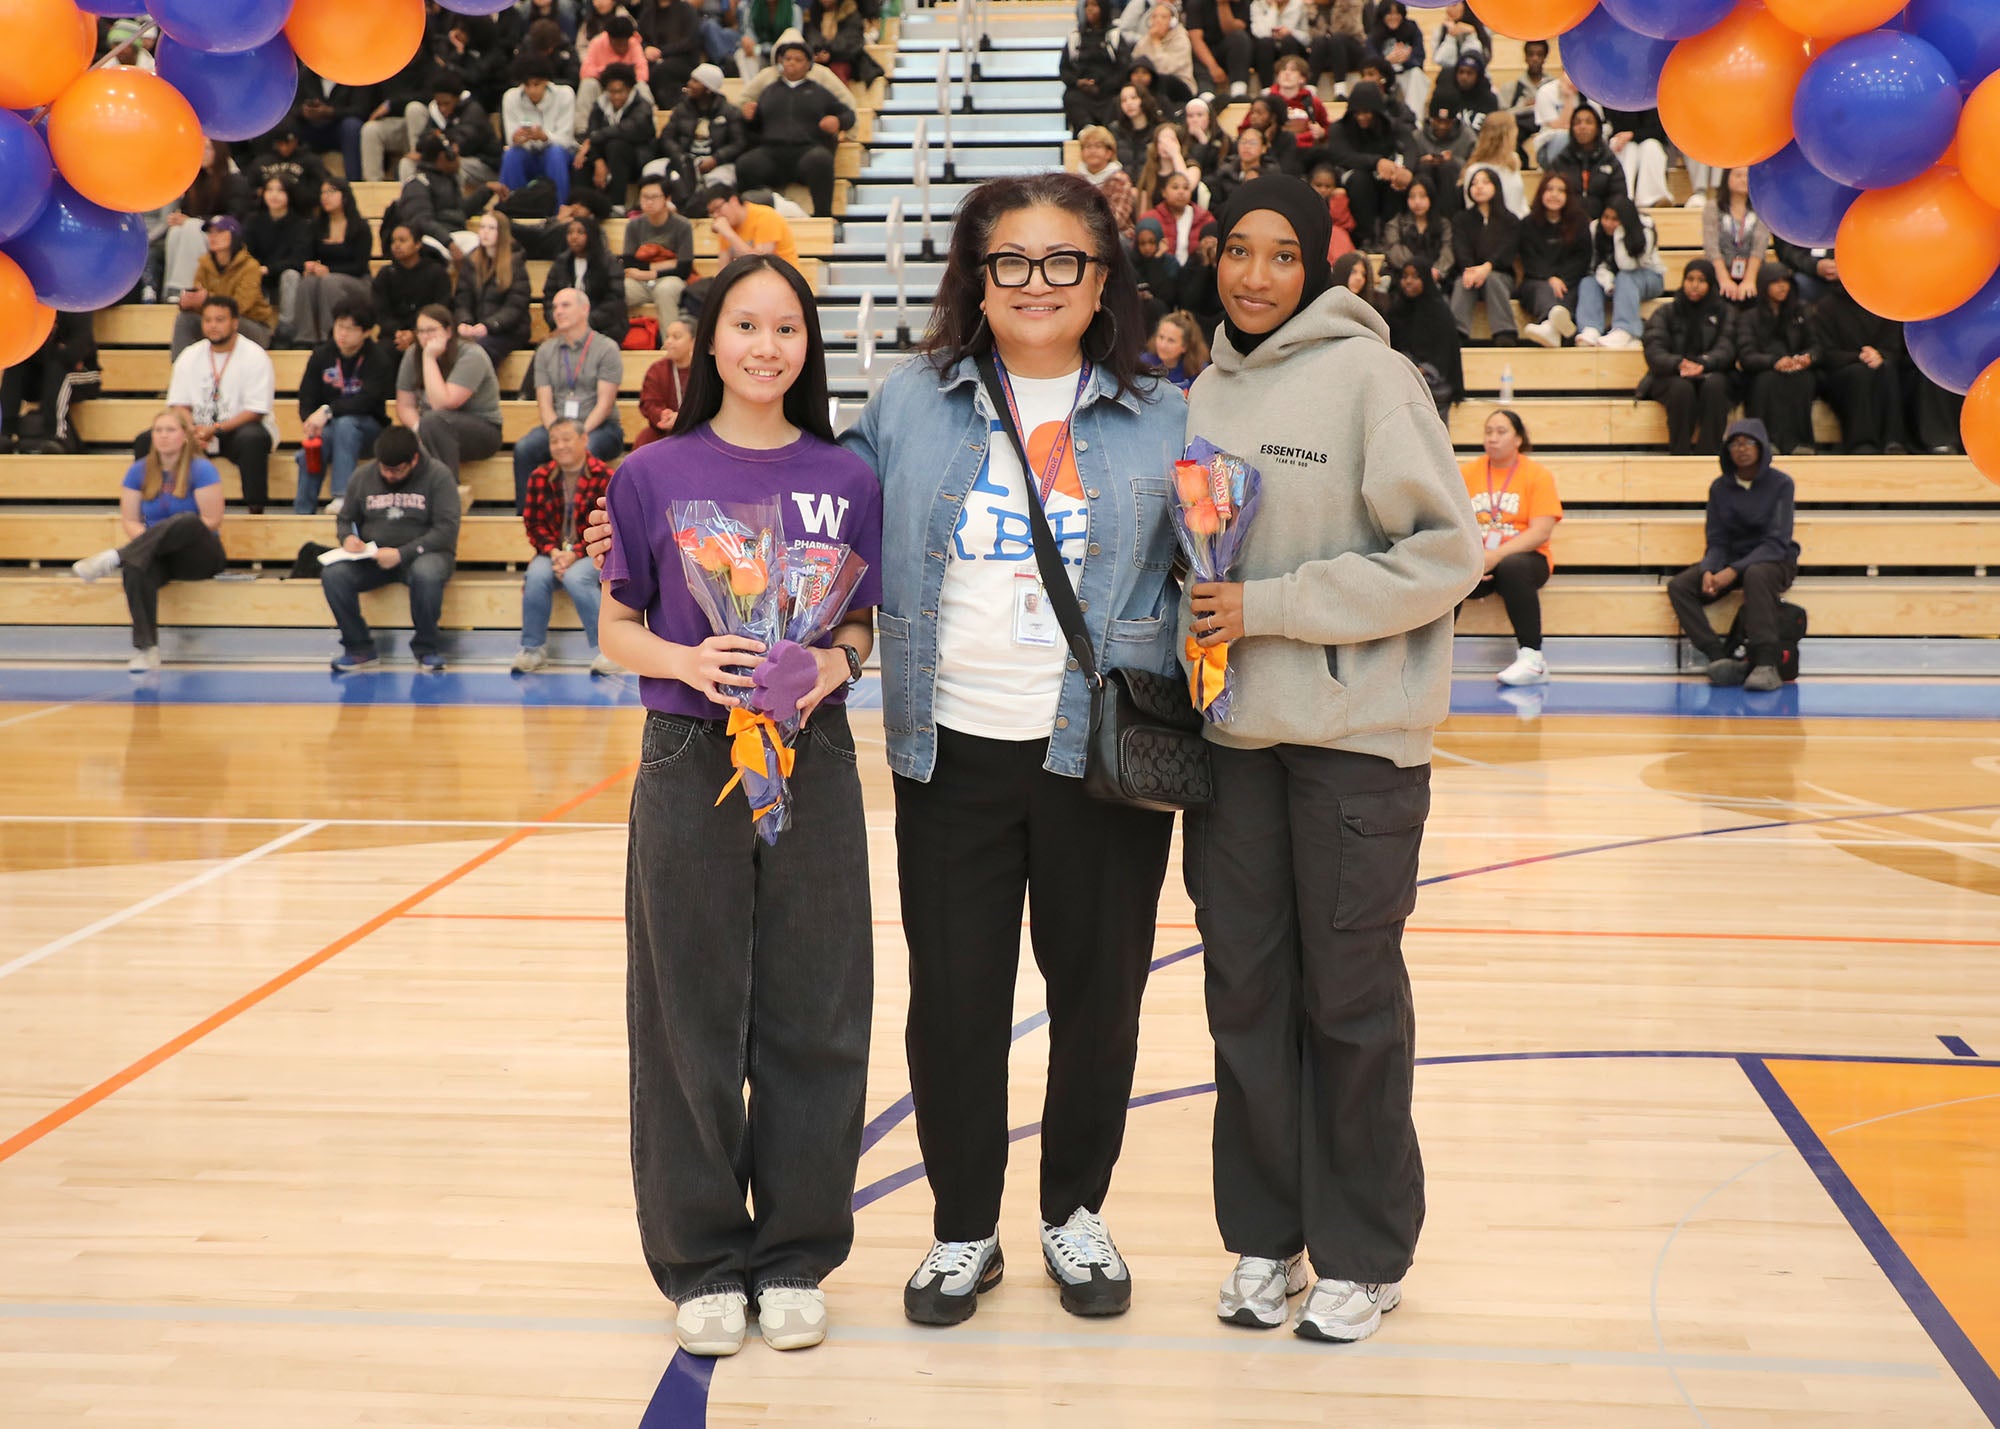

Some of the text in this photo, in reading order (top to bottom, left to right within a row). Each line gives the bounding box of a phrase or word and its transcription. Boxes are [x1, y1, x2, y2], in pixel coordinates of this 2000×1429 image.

[1260, 444, 1328, 464] ESSENTIALS
[1213, 469, 1226, 500] TWIX
[791, 492, 849, 540] W
